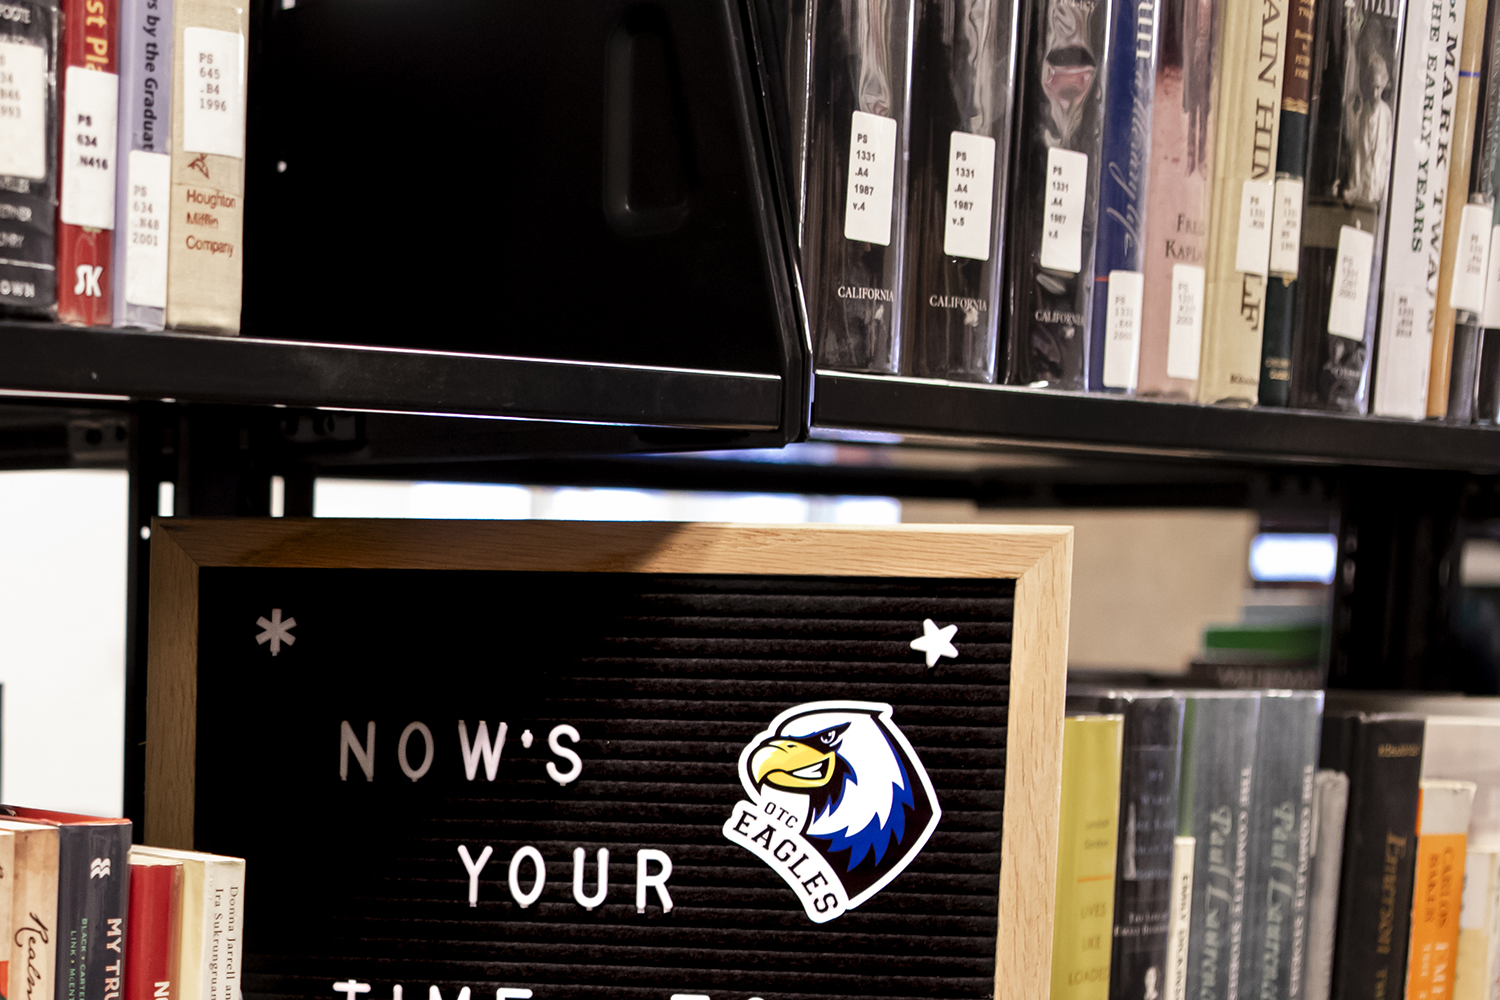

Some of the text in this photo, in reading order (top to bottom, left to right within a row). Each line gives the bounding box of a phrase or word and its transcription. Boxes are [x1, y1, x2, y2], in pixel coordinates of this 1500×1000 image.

[199, 53, 213, 64] PS
[199, 67, 221, 79] 645
[142, 16, 160, 150] by the Graduat
[199, 98, 227, 112] 1996
[1436, 35, 1458, 167] MARK
[857, 134, 868, 144] PS
[856, 150, 876, 162] 1331
[956, 152, 966, 162] PS
[1411, 53, 1438, 253] EARLY YEARS
[855, 167, 869, 177] .A4
[955, 167, 975, 179] 1331
[854, 184, 874, 196] 1987
[954, 183, 968, 194] .A4
[186, 189, 236, 210] Houghton
[852, 202, 866, 211] v.4
[953, 200, 973, 211] 1987
[186, 212, 219, 230] Mifflin
[186, 235, 234, 258] Company
[837, 286, 894, 302] CALIFORNIA
[929, 295, 987, 311] CALIFORNIA
[339, 720, 582, 786] NOW'S
[764, 801, 798, 828] OTC
[733, 810, 838, 913] EAGLES
[457, 844, 675, 914] YOUR
[214, 888, 224, 908] Ira
[229, 886, 239, 932] Donna
[69, 930, 77, 956] LINK
[106, 918, 122, 954] MY
[225, 936, 237, 980] Jarrell
